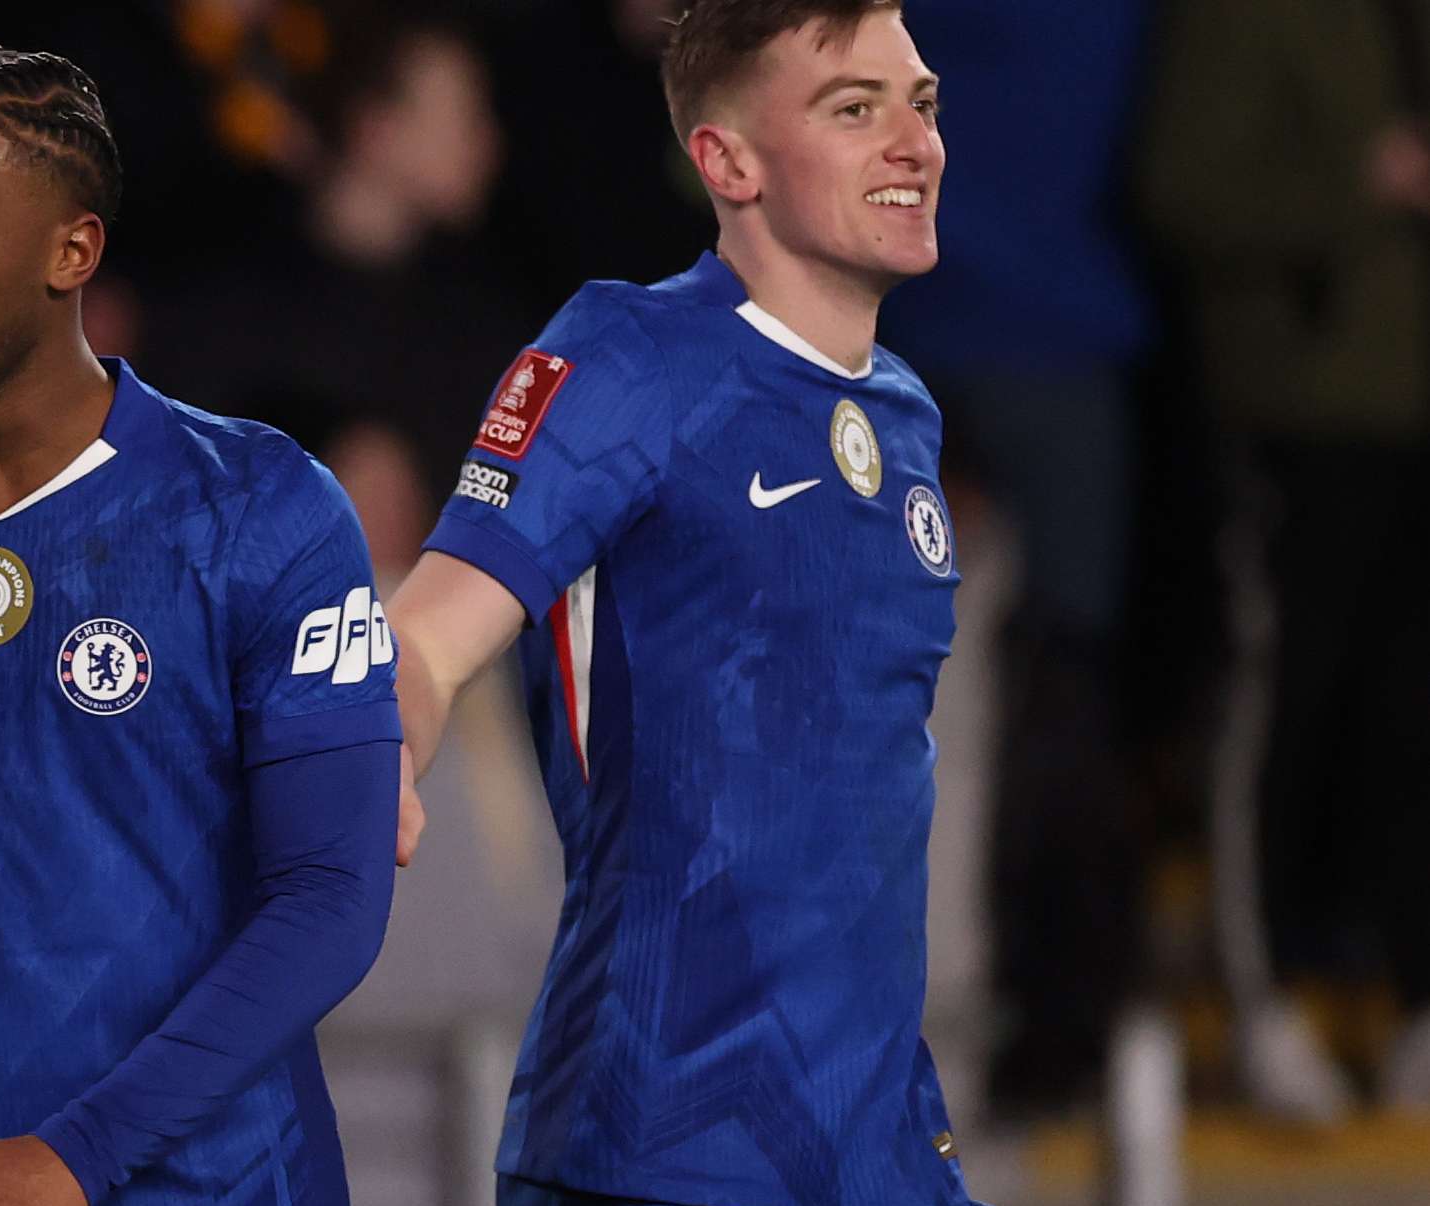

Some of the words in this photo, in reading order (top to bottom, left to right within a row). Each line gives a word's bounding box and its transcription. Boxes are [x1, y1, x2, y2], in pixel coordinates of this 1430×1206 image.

[487, 423, 522, 443] CUP
[456, 479, 510, 509] acism
[74, 622, 133, 643] CHELSEA
